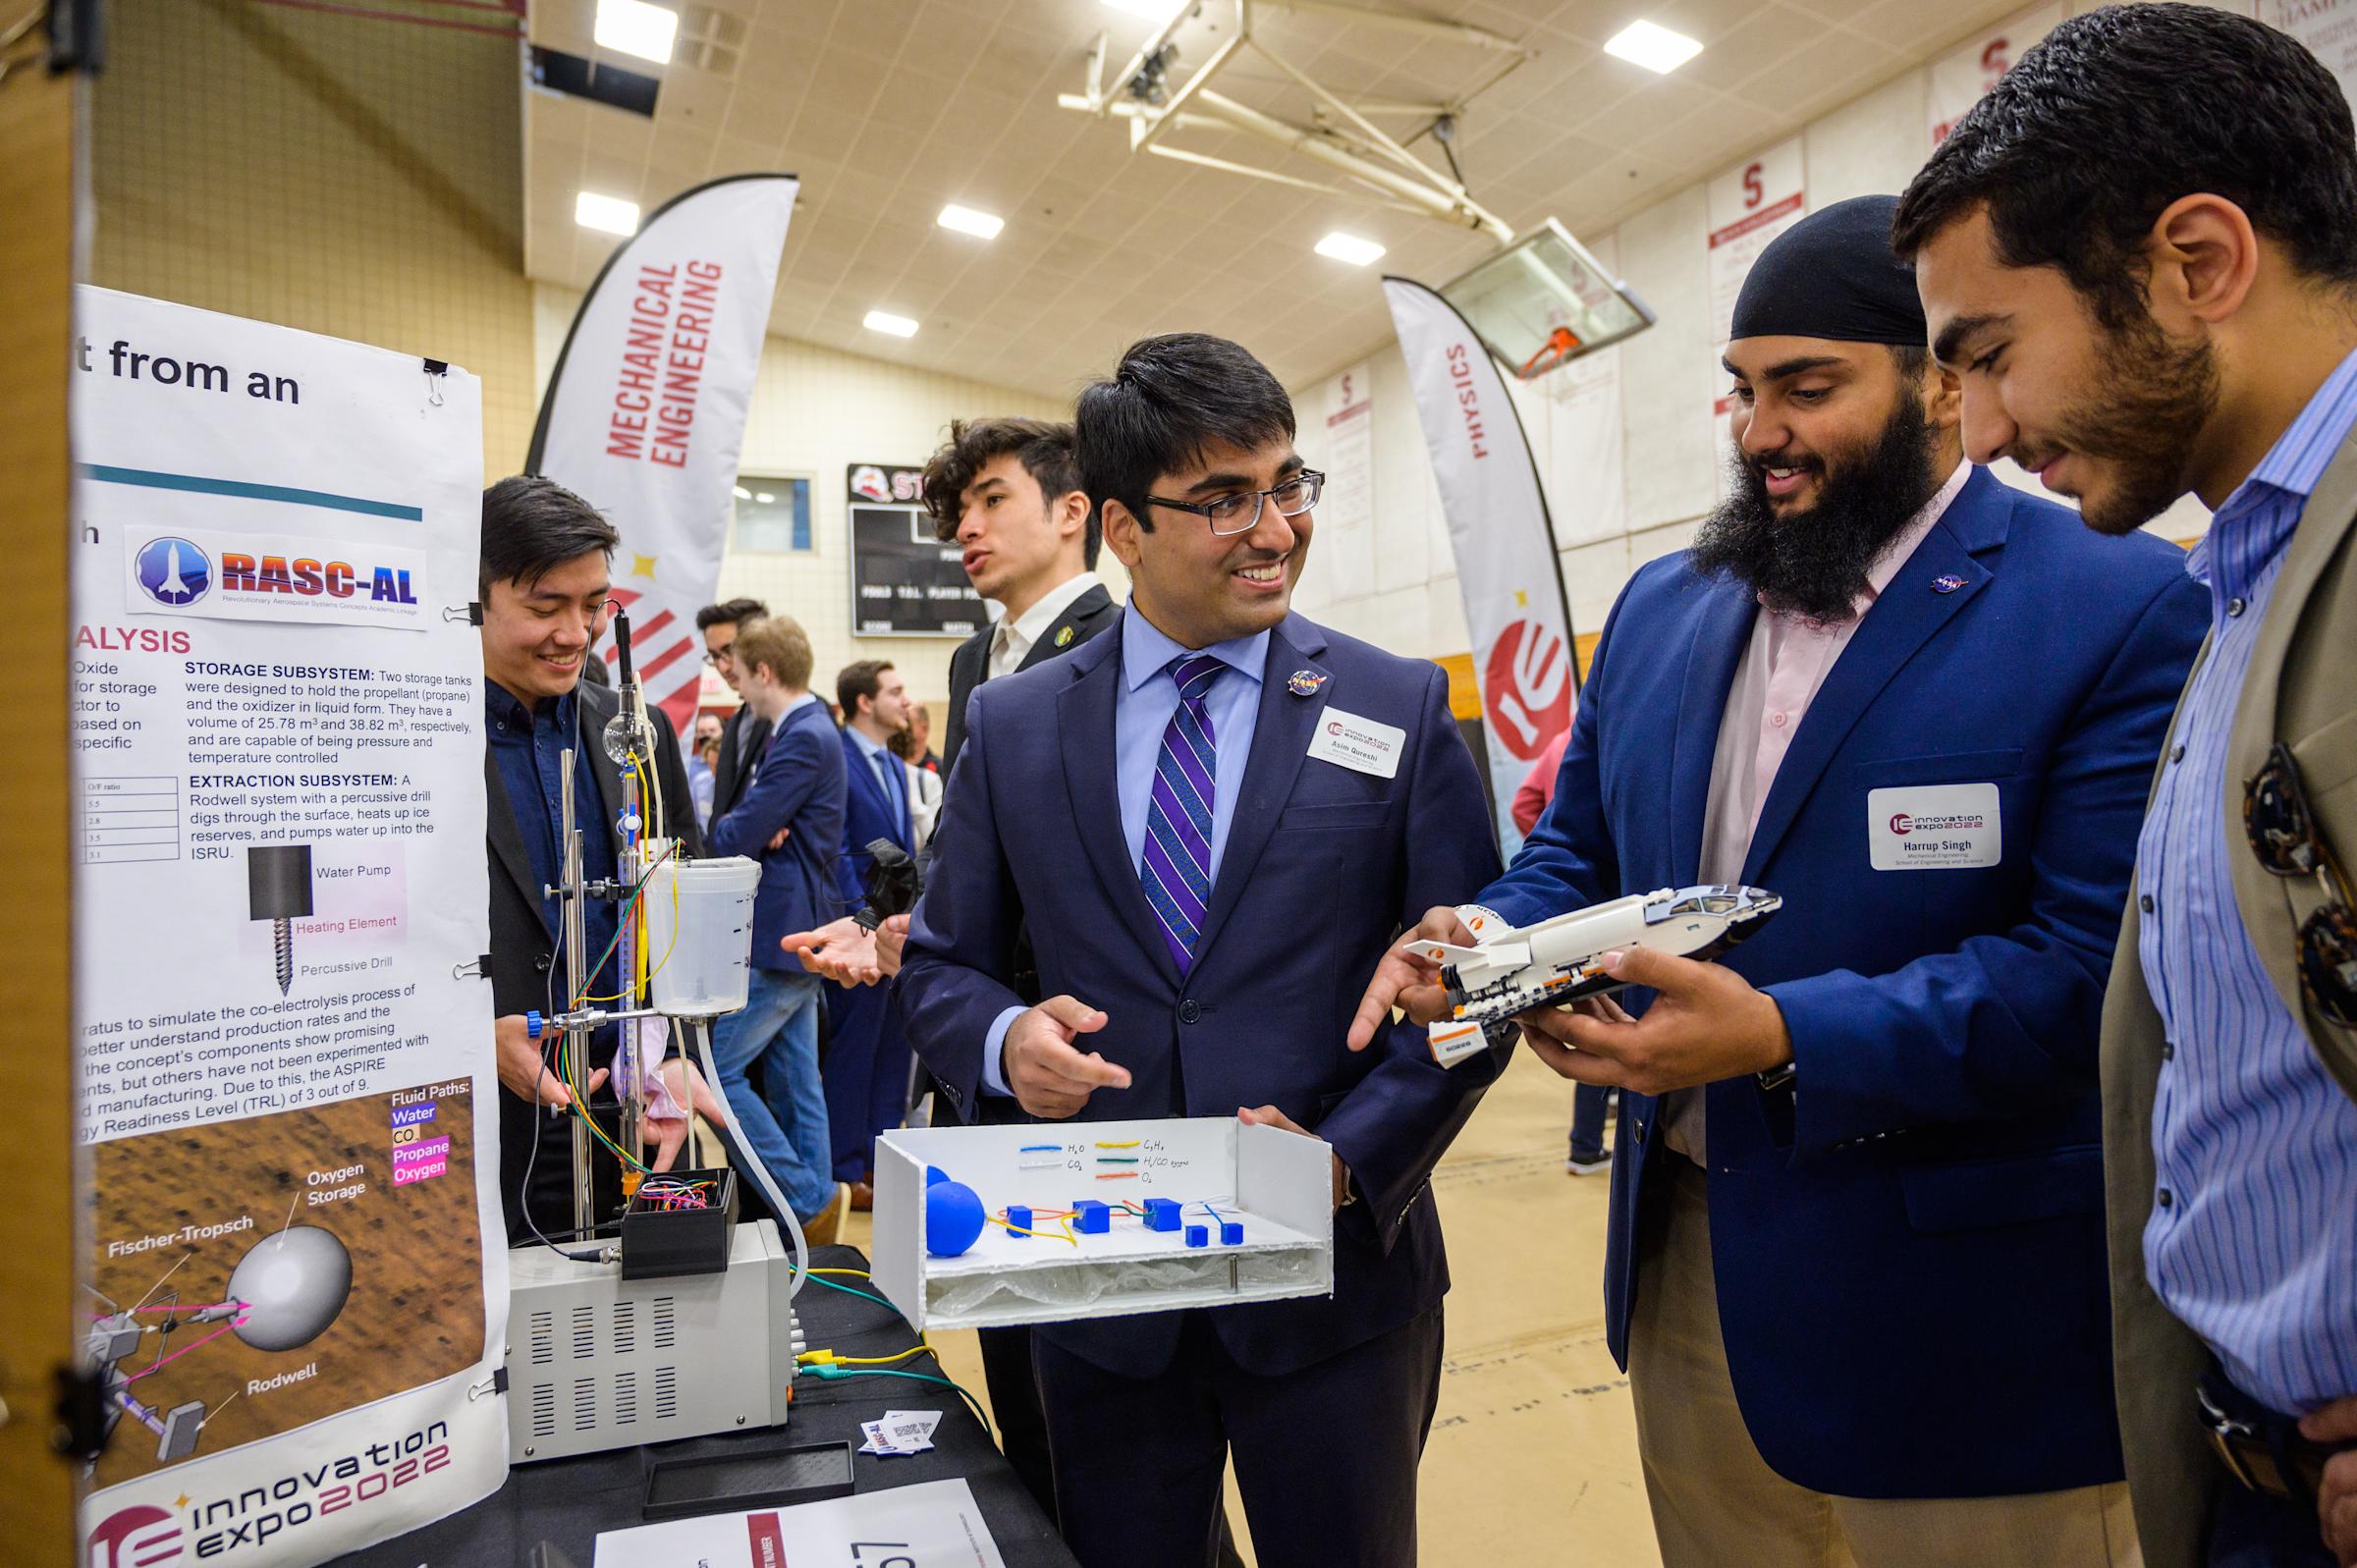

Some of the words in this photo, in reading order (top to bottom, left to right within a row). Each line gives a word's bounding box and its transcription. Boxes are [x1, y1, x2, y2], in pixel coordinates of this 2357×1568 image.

[1742, 161, 1764, 209] S
[606, 262, 678, 460] MECHANICAL
[649, 260, 724, 469] ENGINEERING
[109, 340, 229, 394] from
[247, 369, 301, 405] an
[1447, 343, 1489, 460] PHYSICS
[222, 552, 418, 606] RASC-AL
[222, 595, 271, 605] Revolutionary
[272, 597, 310, 608] Aerospace
[311, 600, 339, 609] Systems
[73, 660, 118, 675] Oxide
[185, 662, 267, 676] STORAGE
[272, 666, 374, 680] SUBSYSTEM:
[379, 671, 402, 682] Two
[405, 674, 442, 686] storage
[445, 676, 471, 686] tanks
[99, 681, 157, 697] storage
[185, 682, 220, 693] were
[223, 681, 287, 697] designed
[291, 684, 303, 696] to
[307, 684, 336, 697] hold
[340, 685, 360, 697] the
[363, 687, 419, 701] propellant
[422, 688, 470, 704] (propane)
[106, 700, 121, 712] to
[187, 698, 212, 710] and
[216, 699, 239, 711] the
[242, 700, 296, 713] oxidizer
[300, 701, 310, 713] in
[315, 701, 350, 716] liquid
[354, 702, 384, 714] form.
[388, 703, 416, 718] They
[418, 704, 443, 716] have
[446, 708, 452, 717] a
[123, 721, 141, 730] on
[187, 716, 238, 729] volume
[241, 717, 255, 729] of
[258, 717, 296, 730] 25.78
[320, 719, 346, 730] and
[349, 719, 384, 730] 38.82
[411, 721, 471, 734] respectively,
[188, 733, 214, 745] and
[219, 736, 241, 746] are
[245, 734, 297, 749] capable
[301, 734, 314, 746] of
[317, 734, 353, 749] being
[356, 737, 411, 749] pressure
[412, 736, 433, 747] and
[1343, 728, 1391, 748] innovation
[189, 751, 272, 766] temperature
[275, 751, 338, 764] controlled
[1331, 740, 1349, 751] Asim
[1350, 746, 1378, 762] Qureshi
[190, 775, 295, 788] EXTRACTION
[300, 775, 397, 786] SUBSYSTEM:
[402, 775, 411, 785] A
[190, 793, 247, 806] Rodwell
[250, 793, 298, 808] system
[301, 792, 326, 804] with
[330, 794, 338, 803] a
[342, 790, 408, 806] percussive
[411, 790, 431, 802] drill
[190, 812, 220, 827] digs
[224, 810, 276, 825] through
[280, 810, 301, 822] the
[304, 808, 354, 821] surface,
[357, 808, 391, 820] heats
[394, 809, 410, 821] up
[413, 806, 430, 818] ice
[1914, 814, 1983, 823] innovation
[1915, 821, 1984, 831] expo2022
[191, 831, 255, 842] reserves,
[260, 827, 285, 839] and
[290, 828, 332, 840] pumps
[335, 826, 369, 837] water
[372, 826, 387, 838] up
[391, 824, 412, 835] into
[415, 822, 434, 834] the
[192, 846, 234, 860] ISRU.
[1903, 841, 1939, 852] Harrup
[1942, 839, 1972, 852] Singh
[316, 867, 355, 879] Water
[357, 865, 391, 877] Pump
[297, 921, 345, 935] Heating
[349, 915, 397, 930] Element
[301, 960, 367, 977] Percussive
[370, 956, 393, 969] Drill
[128, 1018, 143, 1031] to
[148, 1009, 216, 1028] simulate
[221, 1006, 246, 1020] the
[249, 994, 349, 1016] co-electrolysis
[352, 988, 401, 1006] process
[404, 983, 415, 997] of
[130, 1026, 220, 1050] understand
[226, 1018, 302, 1042] production
[306, 1014, 340, 1027] rates
[344, 1007, 367, 1022] and
[371, 1006, 391, 1018] the
[84, 1062, 111, 1077] the
[116, 1050, 193, 1072] concept's
[197, 1038, 292, 1060] components
[295, 1033, 331, 1048] show
[334, 1023, 395, 1045] promising
[122, 1076, 147, 1091] but
[151, 1070, 203, 1086] others
[207, 1064, 246, 1078] have
[250, 1058, 274, 1073] not
[278, 1054, 312, 1069] been
[316, 1037, 402, 1063] experimented
[405, 1034, 429, 1048] with
[98, 1088, 218, 1114] manufacturing.
[224, 1082, 255, 1096] Due
[259, 1078, 274, 1090] to
[278, 1072, 305, 1087] this,
[309, 1068, 331, 1082] the
[333, 1056, 386, 1078] ASPIRE
[392, 1087, 426, 1108] Fluid
[429, 1081, 470, 1100] Paths:
[104, 1110, 191, 1134] Readiness
[195, 1100, 238, 1119] Level
[243, 1093, 286, 1114] (TRL)
[290, 1089, 303, 1104] of
[306, 1088, 315, 1101] 3
[318, 1084, 339, 1099] out
[342, 1080, 356, 1094] of
[357, 1078, 369, 1091] 9.
[393, 1106, 436, 1125] Water
[394, 1141, 450, 1164] Propane
[307, 1163, 364, 1186] Oxygen
[394, 1161, 446, 1183] Oxygen
[308, 1182, 366, 1207] Storage
[108, 1215, 254, 1259] Fischer-Tropsch
[247, 1363, 319, 1396] Rodwell
[192, 1420, 448, 1532] innovation
[196, 1443, 452, 1559] expo2022
[761, 1535, 775, 1561] NUMBER
